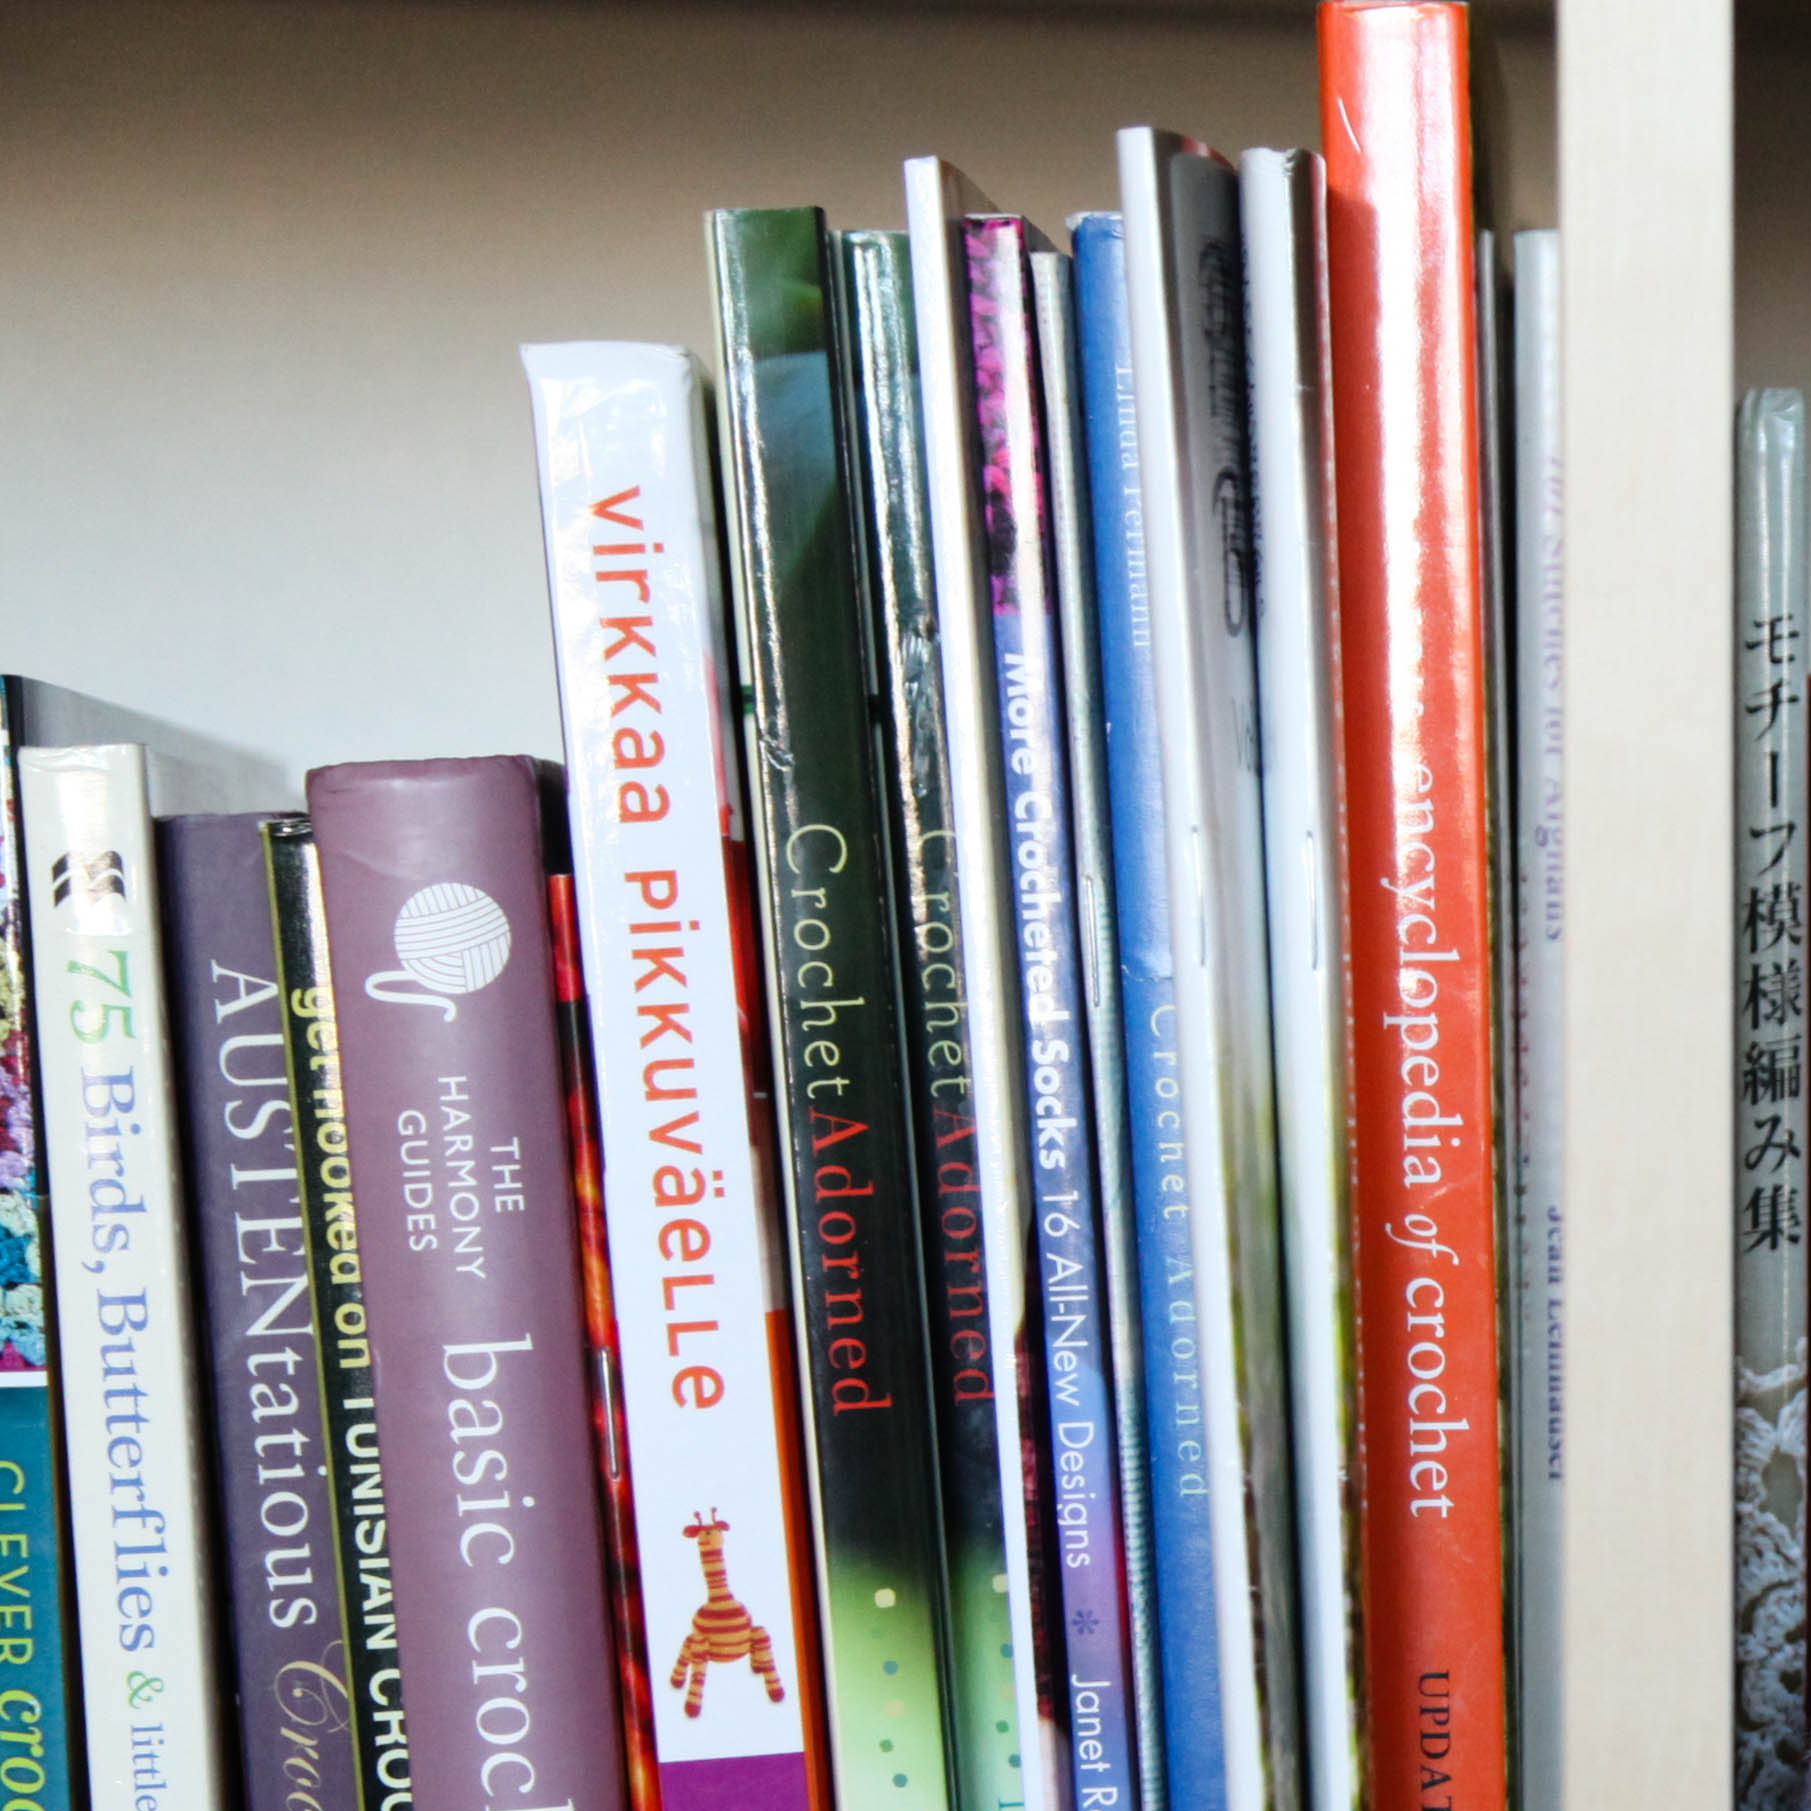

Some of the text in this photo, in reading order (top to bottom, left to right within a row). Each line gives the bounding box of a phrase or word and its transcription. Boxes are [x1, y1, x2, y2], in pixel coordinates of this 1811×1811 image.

[63, 950, 135, 1045] 75
[1741, 612, 1803, 1255] モチーフ模様編み集
[79, 1066, 147, 1271] Birds,
[397, 1109, 438, 1254] GUIDES
[436, 1075, 488, 1280] HARMONY
[489, 1136, 527, 1214] THE
[785, 823, 893, 1416] Crochet Adorned
[918, 830, 997, 1408] Crochet Adorned
[1001, 653, 1097, 1570] More Crocheted Socks 16 All-New Designs
[1380, 761, 1470, 1520] encyclopedia of crochet
[330, 1301, 371, 1369] on
[1149, 1004, 1209, 1500] Crochet Adorned
[96, 1287, 171, 1654] Butterflies
[441, 1333, 537, 1570] basic
[126, 1670, 165, 1709] &
[1071, 1674, 1111, 1772] Janet
